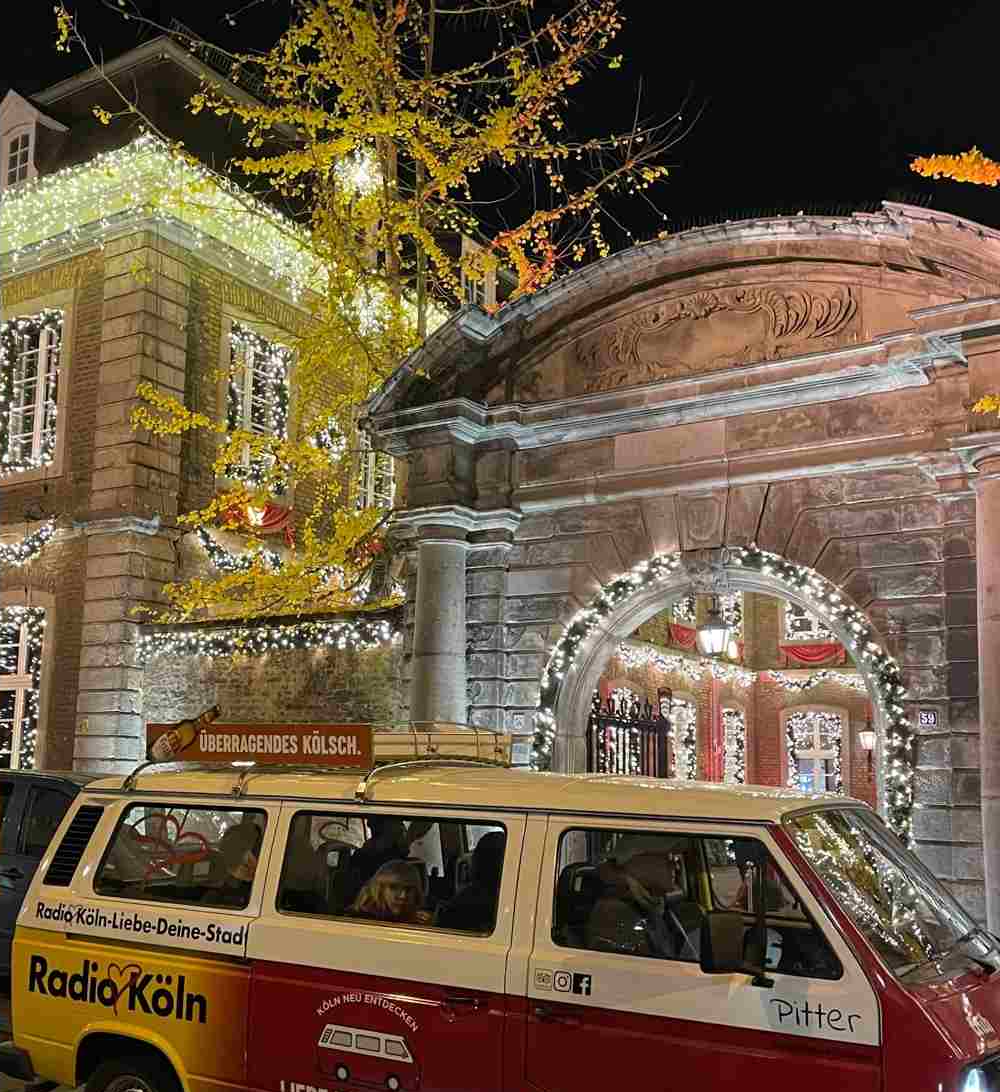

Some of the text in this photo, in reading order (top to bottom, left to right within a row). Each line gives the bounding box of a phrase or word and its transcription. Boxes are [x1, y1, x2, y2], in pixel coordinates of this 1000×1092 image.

[920, 711, 936, 724] 59
[199, 729, 298, 754] ÜBERRAGENDES
[302, 730, 362, 755] KÖLSCH.
[35, 902, 74, 922] Radio
[28, 954, 208, 1024] Radio Köln
[316, 992, 419, 1033] KÖLN NEU ENTDECKEN
[769, 998, 862, 1033] Pitter
